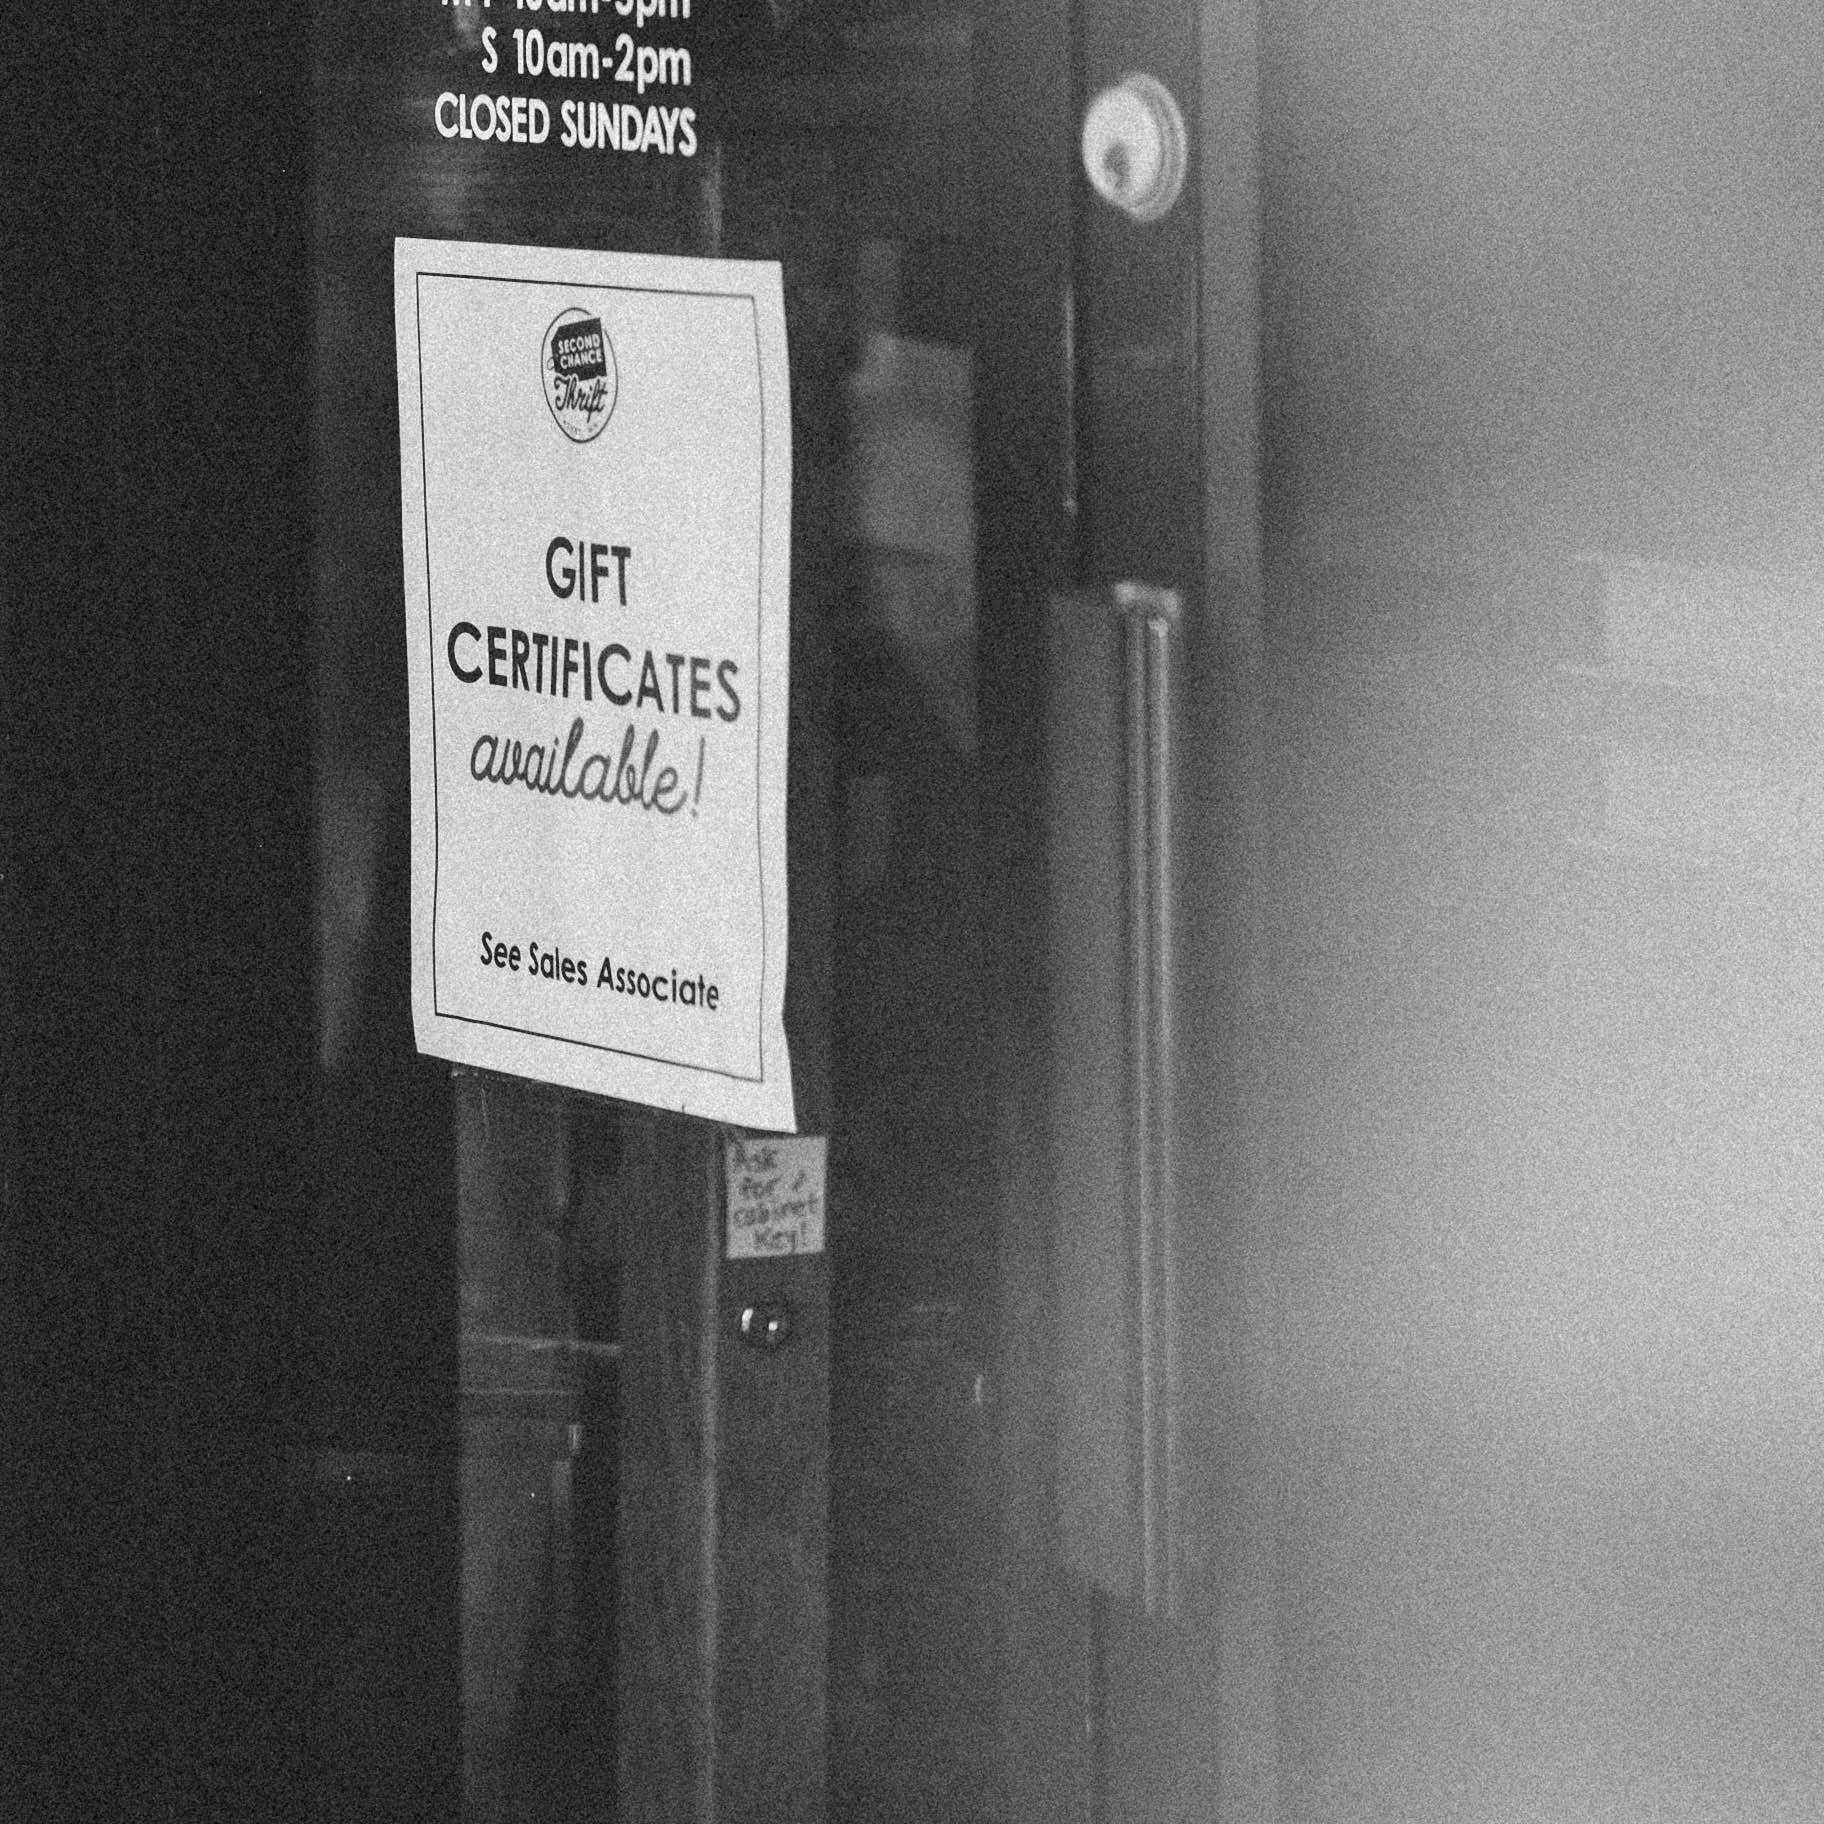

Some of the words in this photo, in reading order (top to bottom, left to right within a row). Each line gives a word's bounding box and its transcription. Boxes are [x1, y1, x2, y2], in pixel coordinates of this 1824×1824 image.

[482, 28, 499, 74] S
[512, 30, 692, 94] 10am-2pm
[434, 92, 550, 144] CLOSED
[560, 100, 698, 157] SUNDAYS
[558, 334, 601, 355] SECOND
[560, 348, 604, 370] CHANCE
[554, 375, 608, 424] Thrift
[545, 536, 632, 606] GIFT
[447, 621, 742, 723] CERTIFICATES
[469, 717, 706, 818] available!
[480, 931, 522, 972] See
[528, 941, 589, 986] Sales
[596, 956, 721, 1012] Associate
